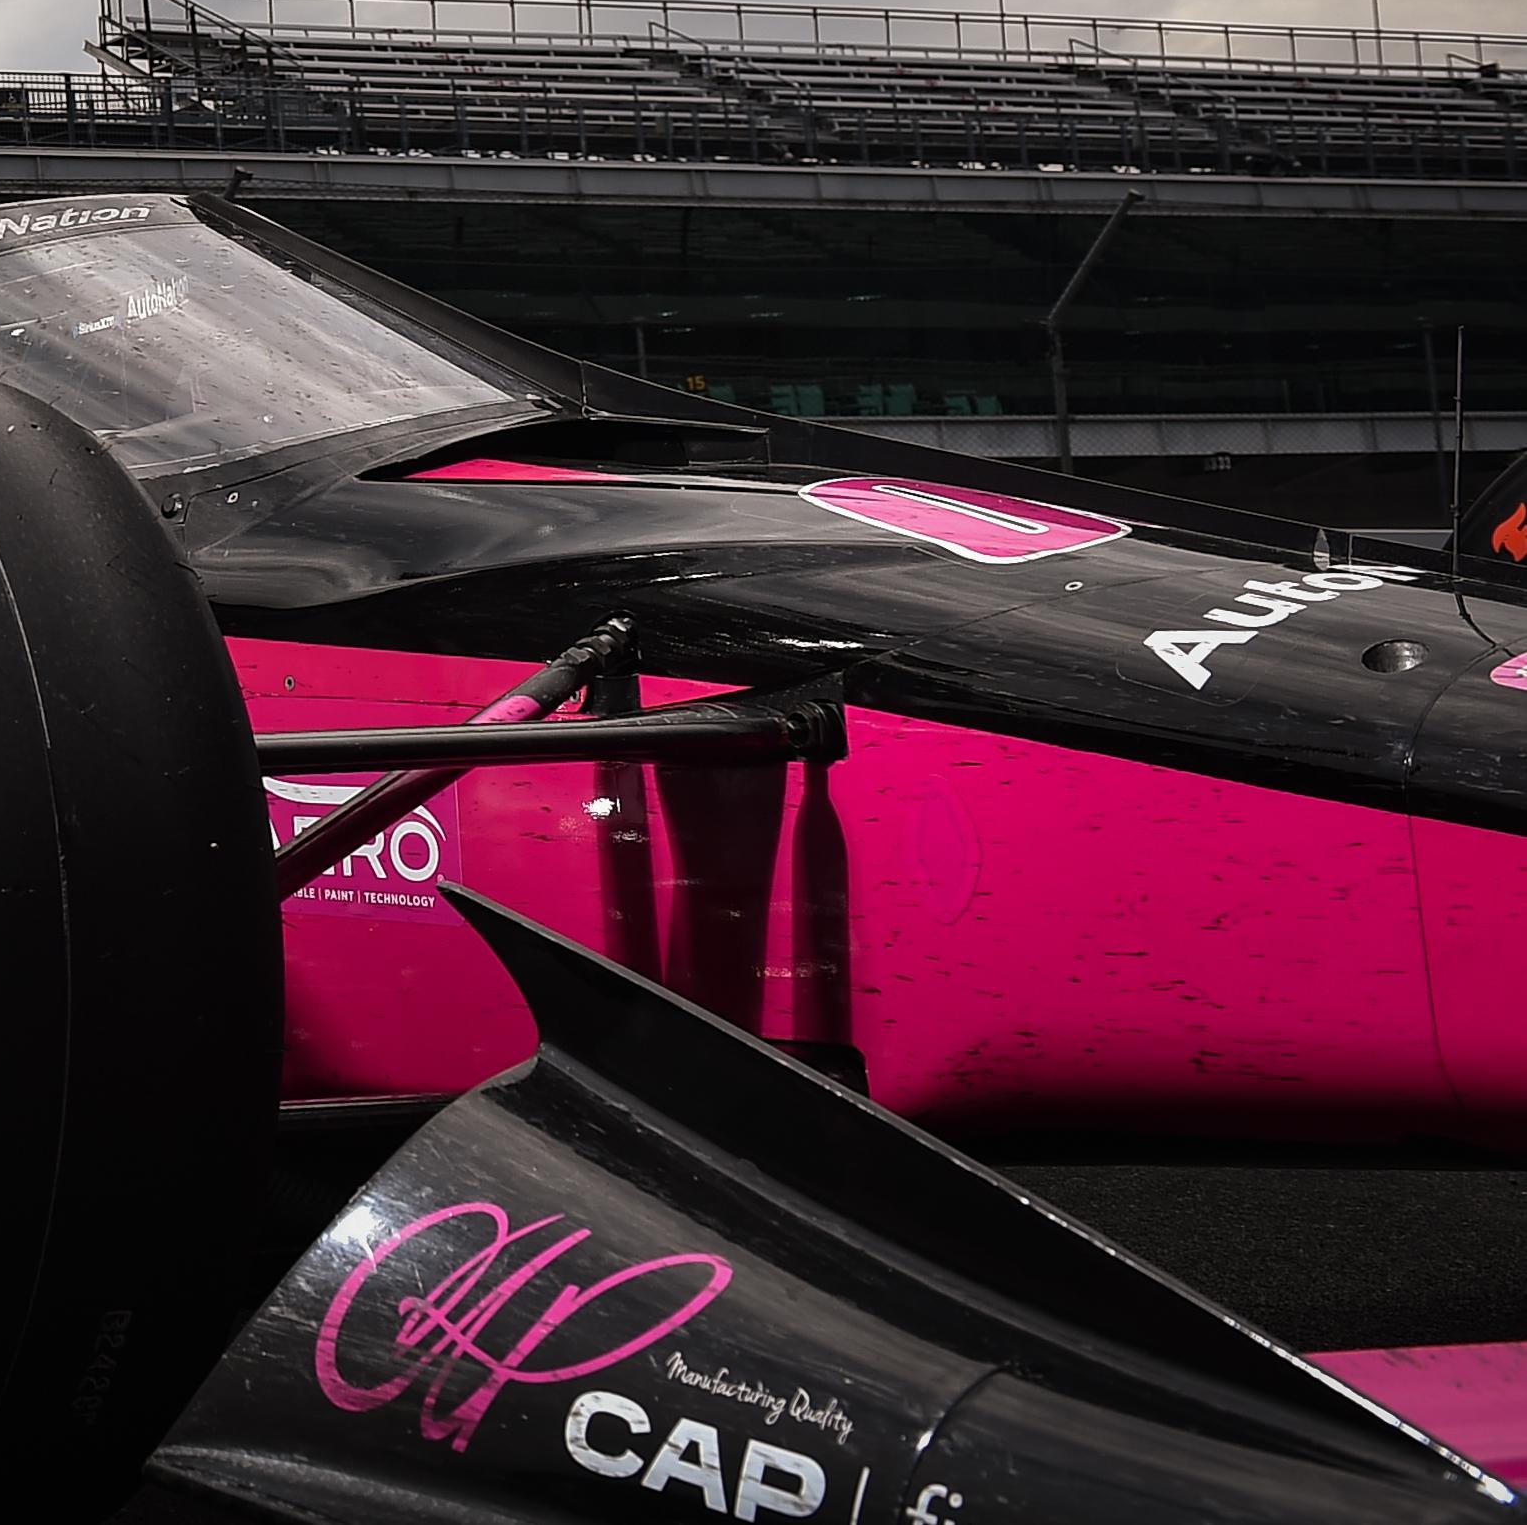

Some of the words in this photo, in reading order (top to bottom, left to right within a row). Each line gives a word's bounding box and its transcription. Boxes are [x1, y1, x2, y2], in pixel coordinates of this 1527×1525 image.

[324, 889, 355, 901] PAINT
[363, 892, 436, 908] TECHNOLOGY
[666, 1350, 787, 1426] Manufacturing
[789, 1386, 854, 1446] Quality
[564, 1390, 827, 1523] CAP
